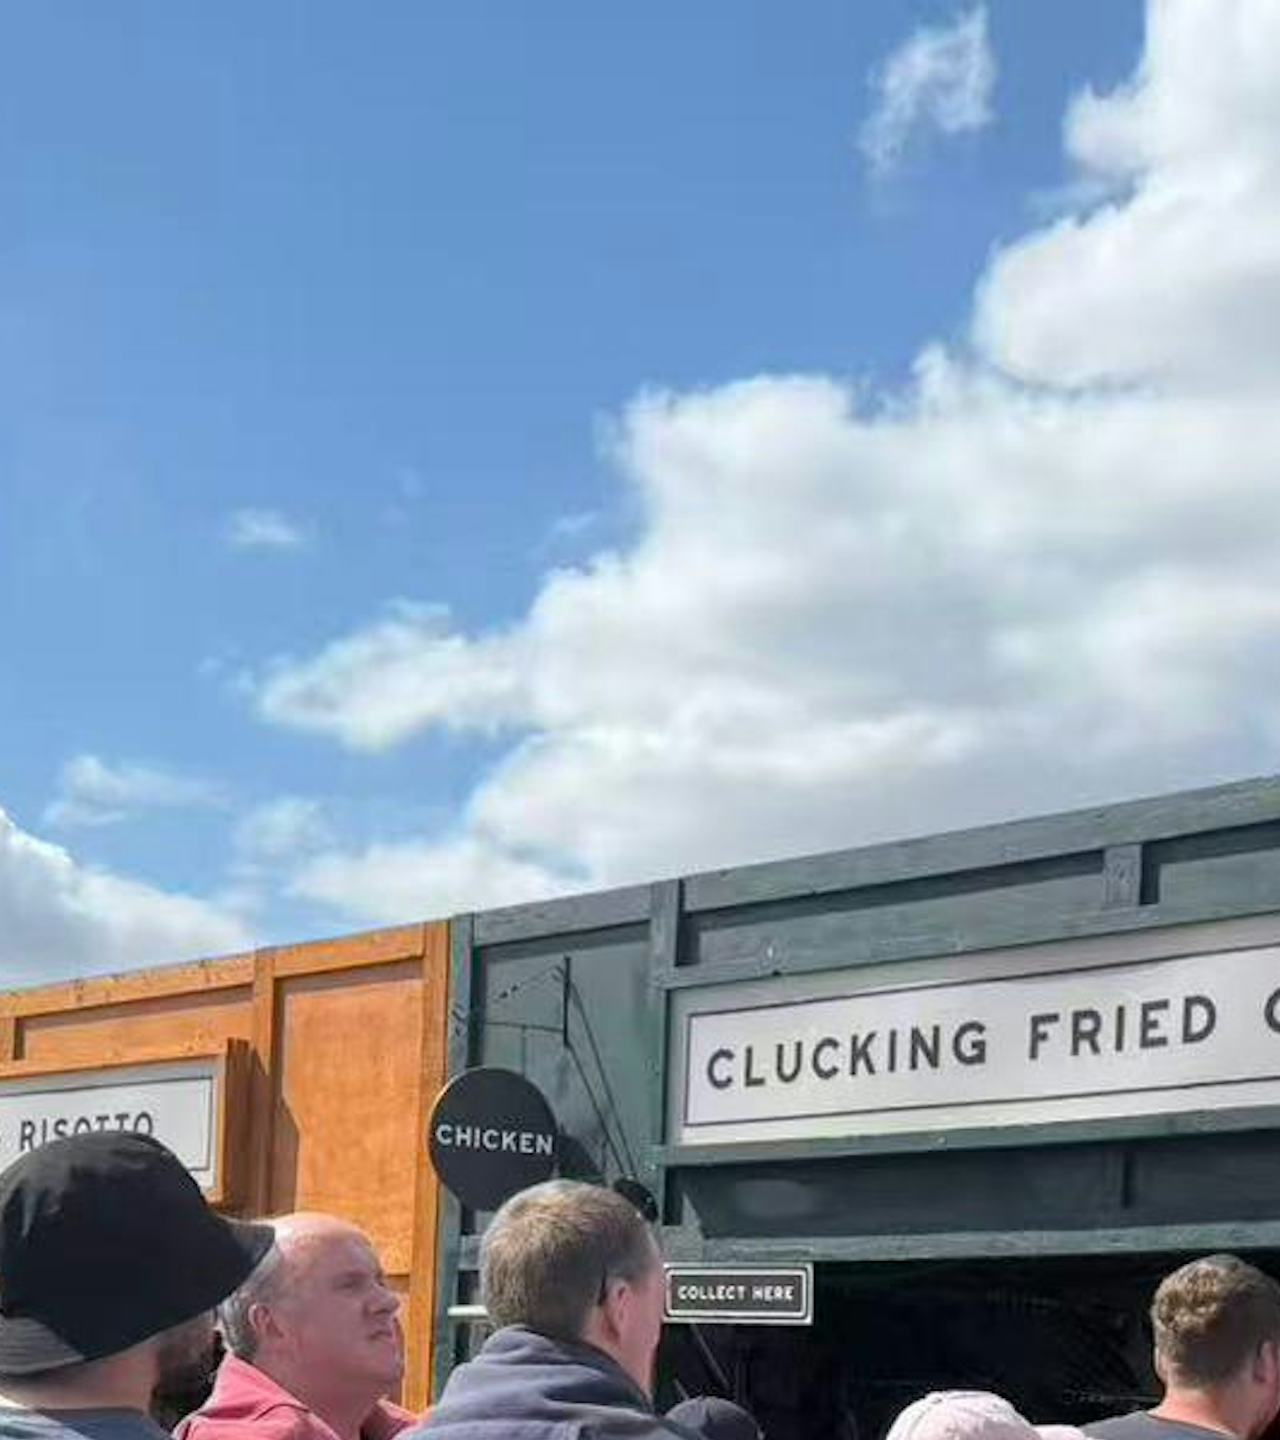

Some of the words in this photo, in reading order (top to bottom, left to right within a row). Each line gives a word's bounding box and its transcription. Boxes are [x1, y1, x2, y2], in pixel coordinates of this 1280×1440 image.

[706, 1019, 988, 1091] CLUCKING
[1027, 995, 1217, 1061] FRIED
[436, 1124, 554, 1156] CHICKEN
[677, 1285, 745, 1300] COLLECT
[751, 1285, 795, 1301] HERE
